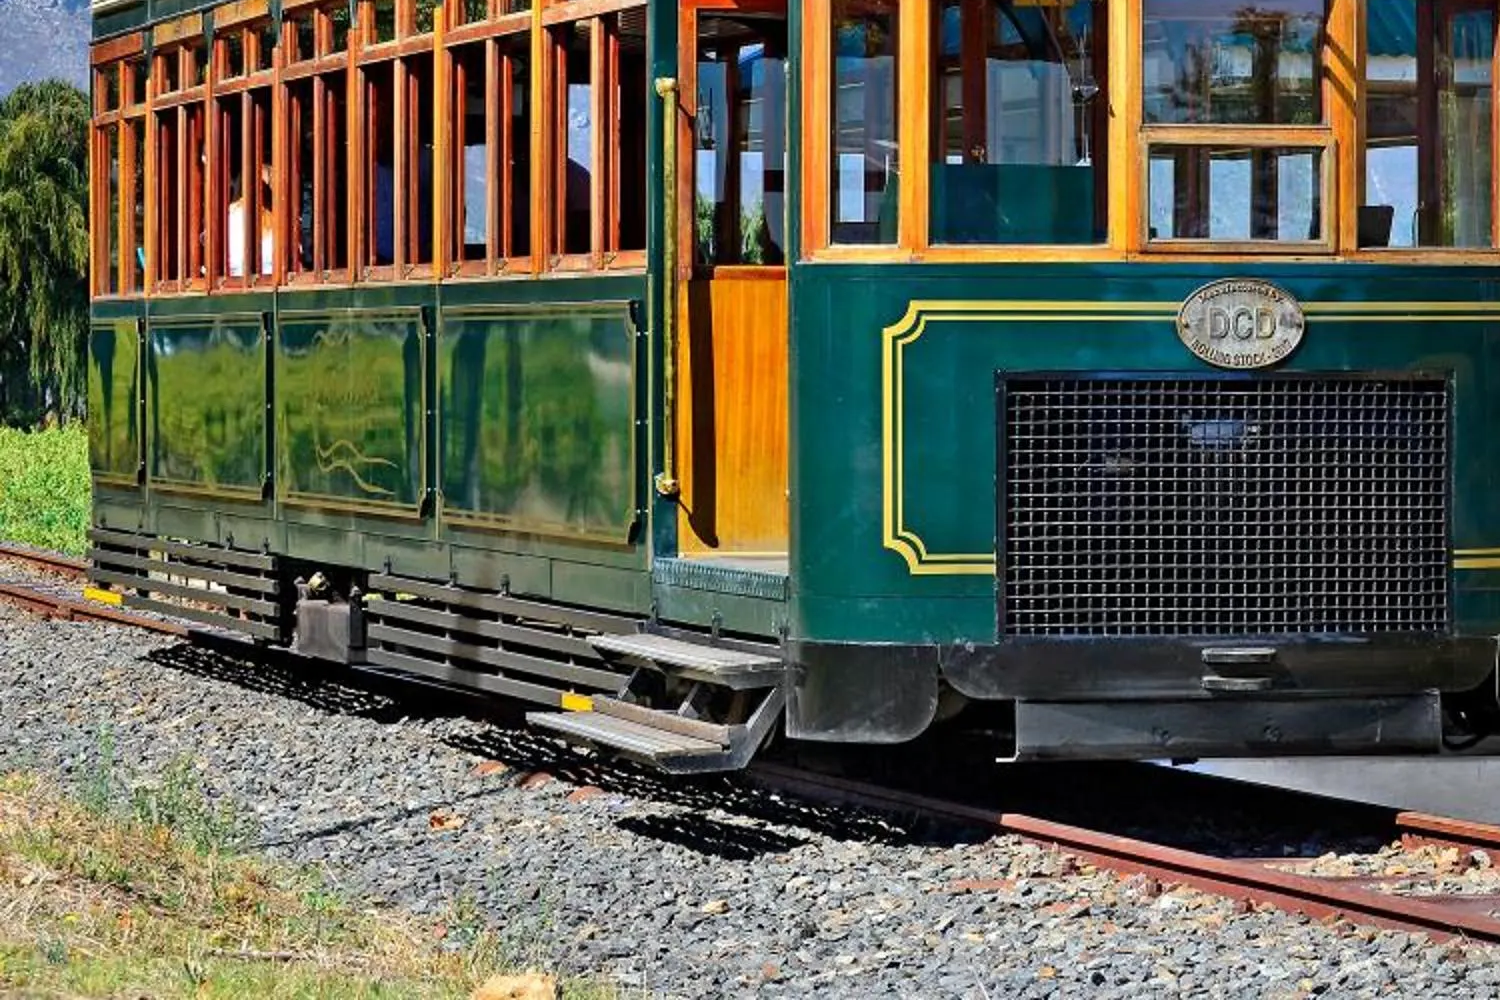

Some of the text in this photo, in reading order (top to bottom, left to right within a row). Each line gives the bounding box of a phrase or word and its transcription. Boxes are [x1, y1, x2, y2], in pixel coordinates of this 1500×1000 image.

[1208, 306, 1277, 341] DCD
[1191, 338, 1232, 365] ROLLING
[1233, 352, 1265, 367] STOCK
